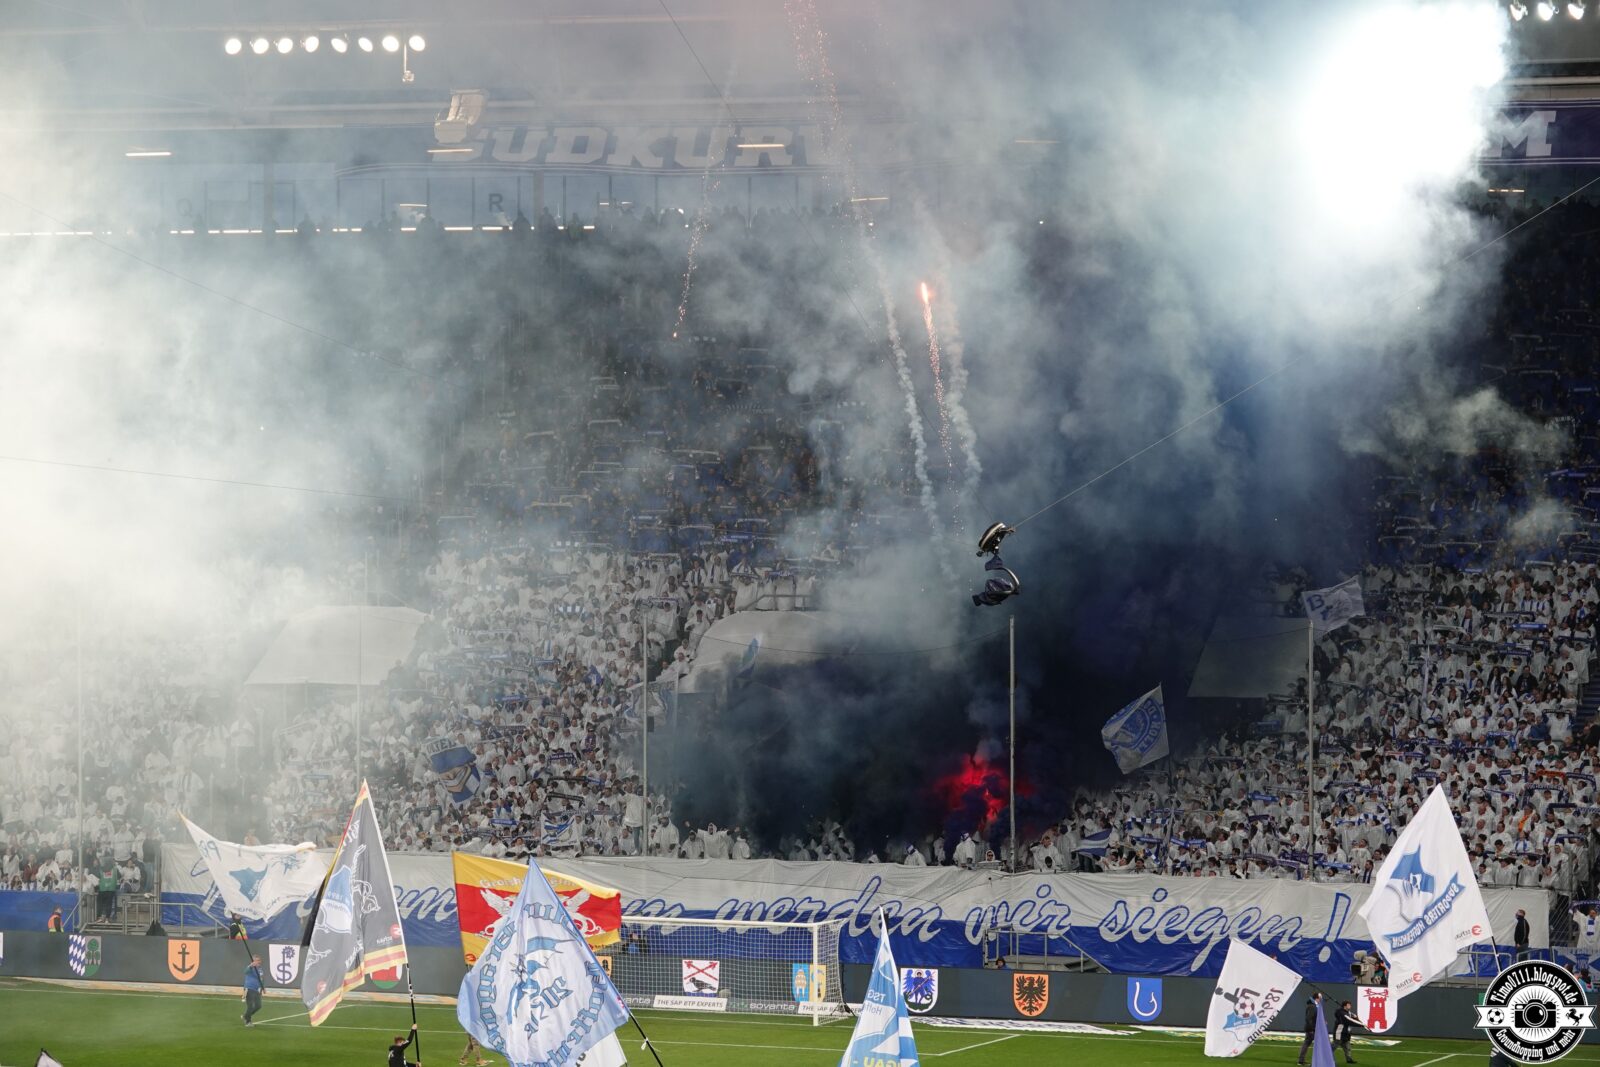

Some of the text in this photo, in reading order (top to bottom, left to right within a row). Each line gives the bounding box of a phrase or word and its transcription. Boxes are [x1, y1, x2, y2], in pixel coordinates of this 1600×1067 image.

[714, 875, 943, 943] werden
[964, 883, 1072, 946] wir
[697, 1001, 724, 1009] EXPERTS
[749, 1002, 796, 1011] sovanta
